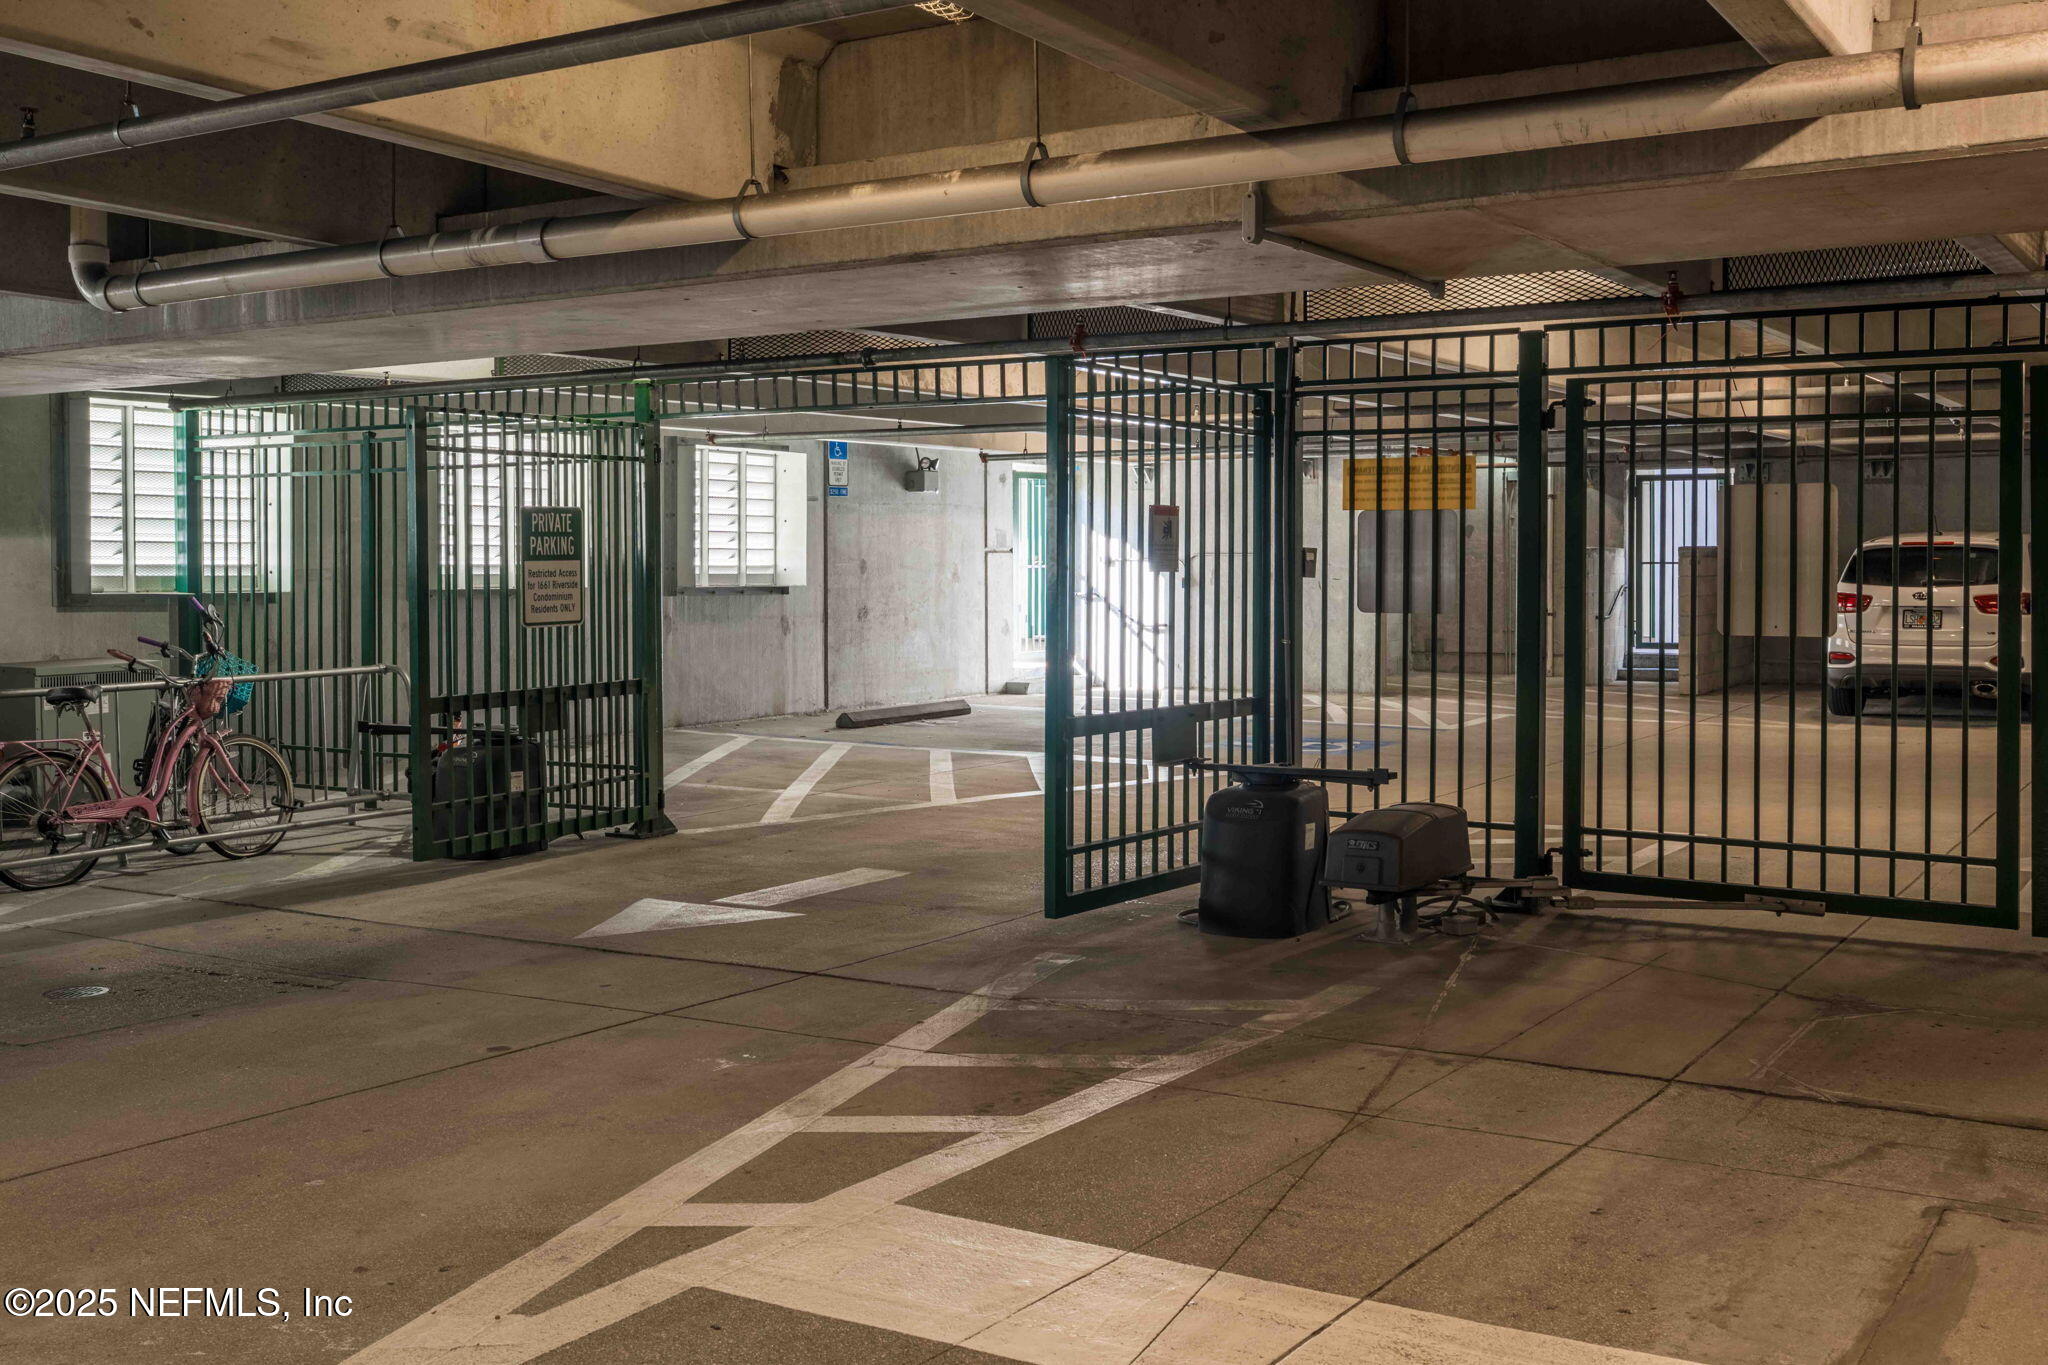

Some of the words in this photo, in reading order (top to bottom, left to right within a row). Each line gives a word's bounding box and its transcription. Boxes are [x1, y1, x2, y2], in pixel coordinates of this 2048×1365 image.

[531, 512, 573, 533] PRIVATE
[530, 536, 575, 556] PARKING
[528, 569, 557, 578] Restricted
[559, 569, 577, 577] Access
[527, 581, 535, 590] for
[538, 581, 550, 590] 1661
[552, 580, 578, 589] Riverside
[533, 592, 574, 602] Condominium
[531, 604, 558, 614] Residents
[560, 603, 576, 612] ONLY
